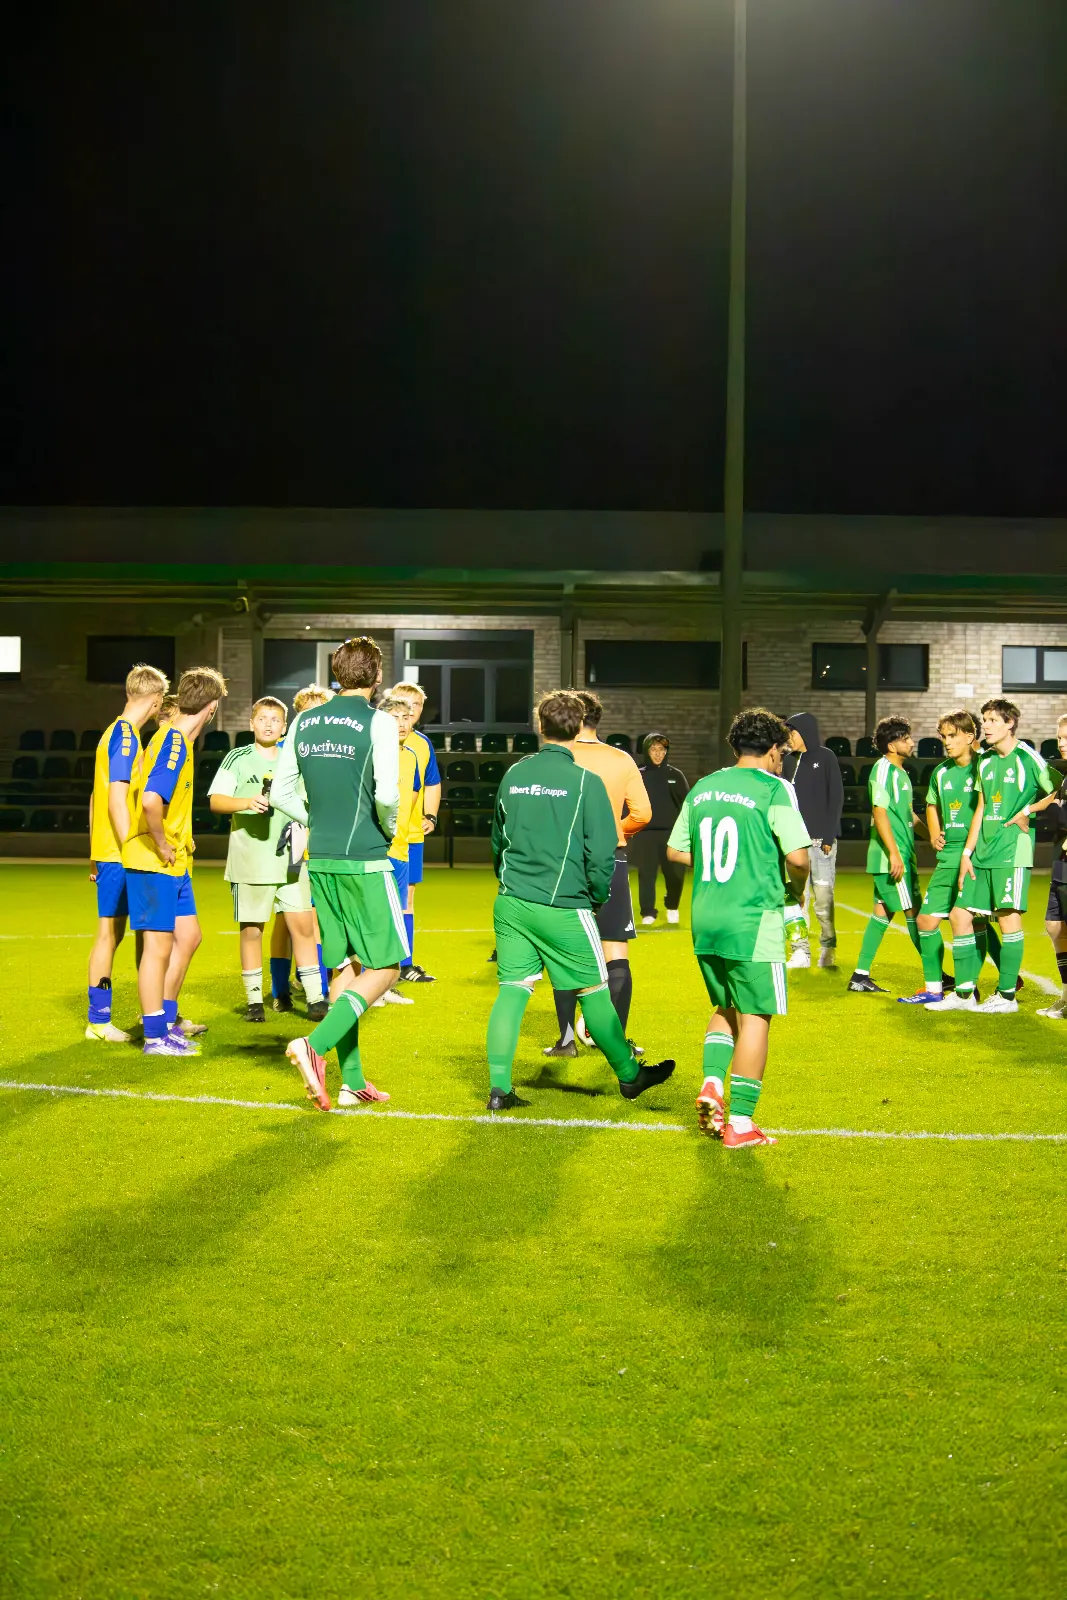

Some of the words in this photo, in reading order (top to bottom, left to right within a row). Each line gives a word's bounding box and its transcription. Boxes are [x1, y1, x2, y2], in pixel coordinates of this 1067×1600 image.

[300, 716, 320, 731] SFN
[324, 716, 364, 732] Vechta
[693, 791, 712, 806] SFN
[715, 791, 756, 809] Vechta
[699, 816, 738, 883] 10
[1005, 878, 1011, 892] 5
